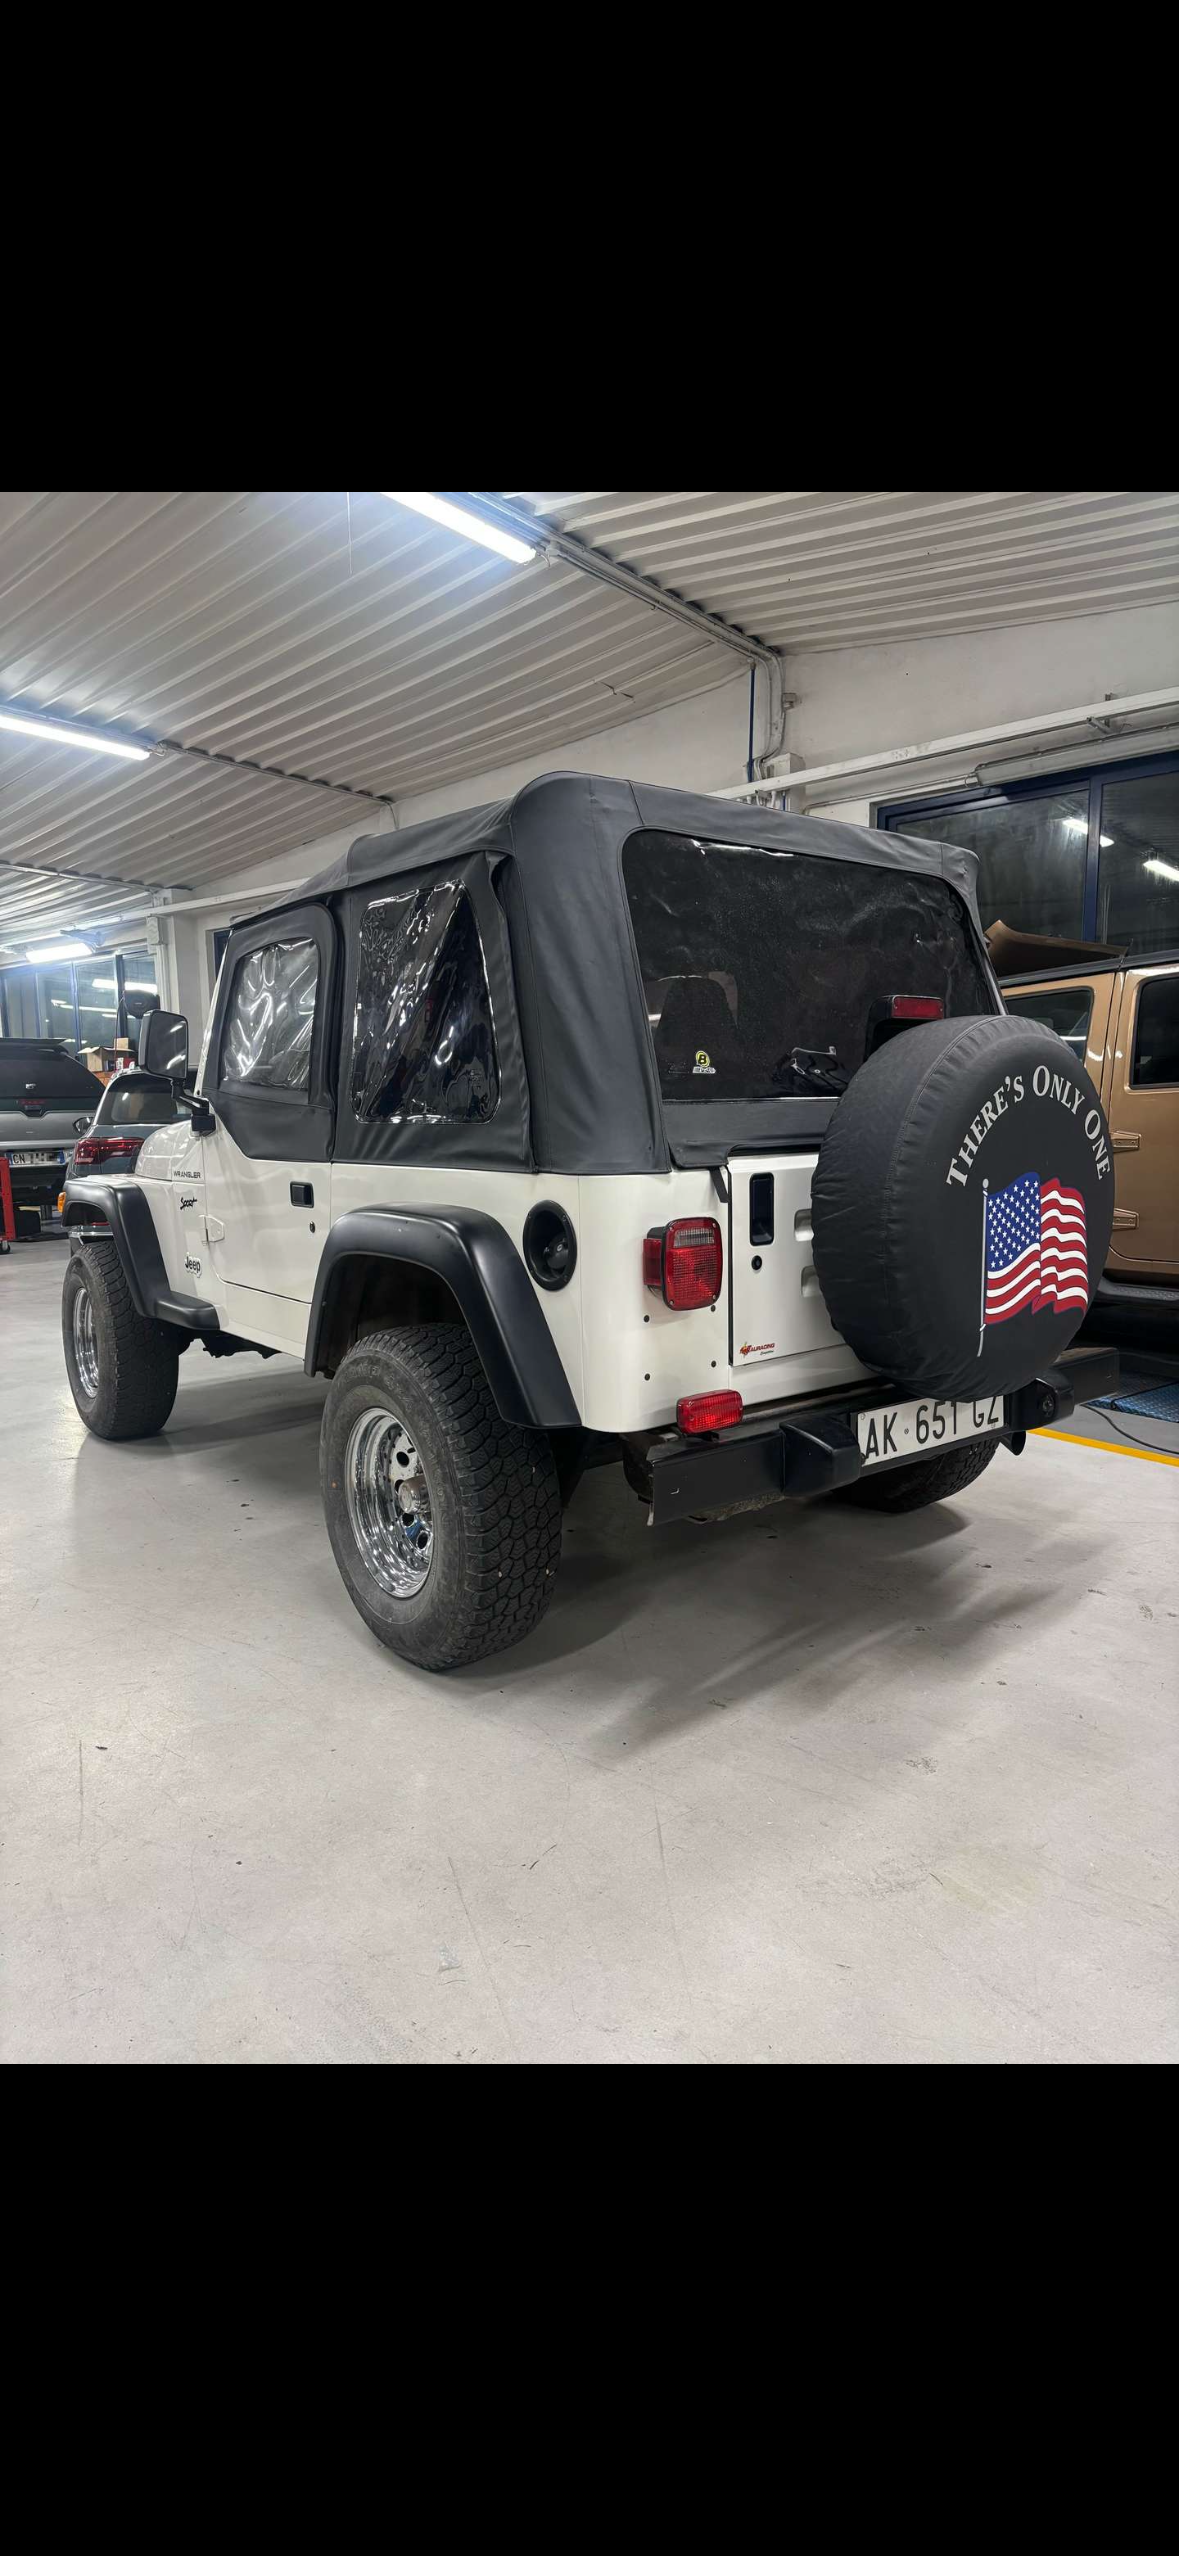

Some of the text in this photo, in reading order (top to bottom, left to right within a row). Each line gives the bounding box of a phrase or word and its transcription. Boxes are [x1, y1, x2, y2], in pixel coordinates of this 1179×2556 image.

[1032, 1065, 1086, 1115] ONLY
[1084, 1109, 1111, 1181] ONE
[173, 1171, 201, 1179] WRANGLER
[180, 1197, 197, 1210] Sport
[185, 1256, 201, 1273] Jeep
[866, 1412, 898, 1459] AK
[916, 1401, 957, 1444] 651
